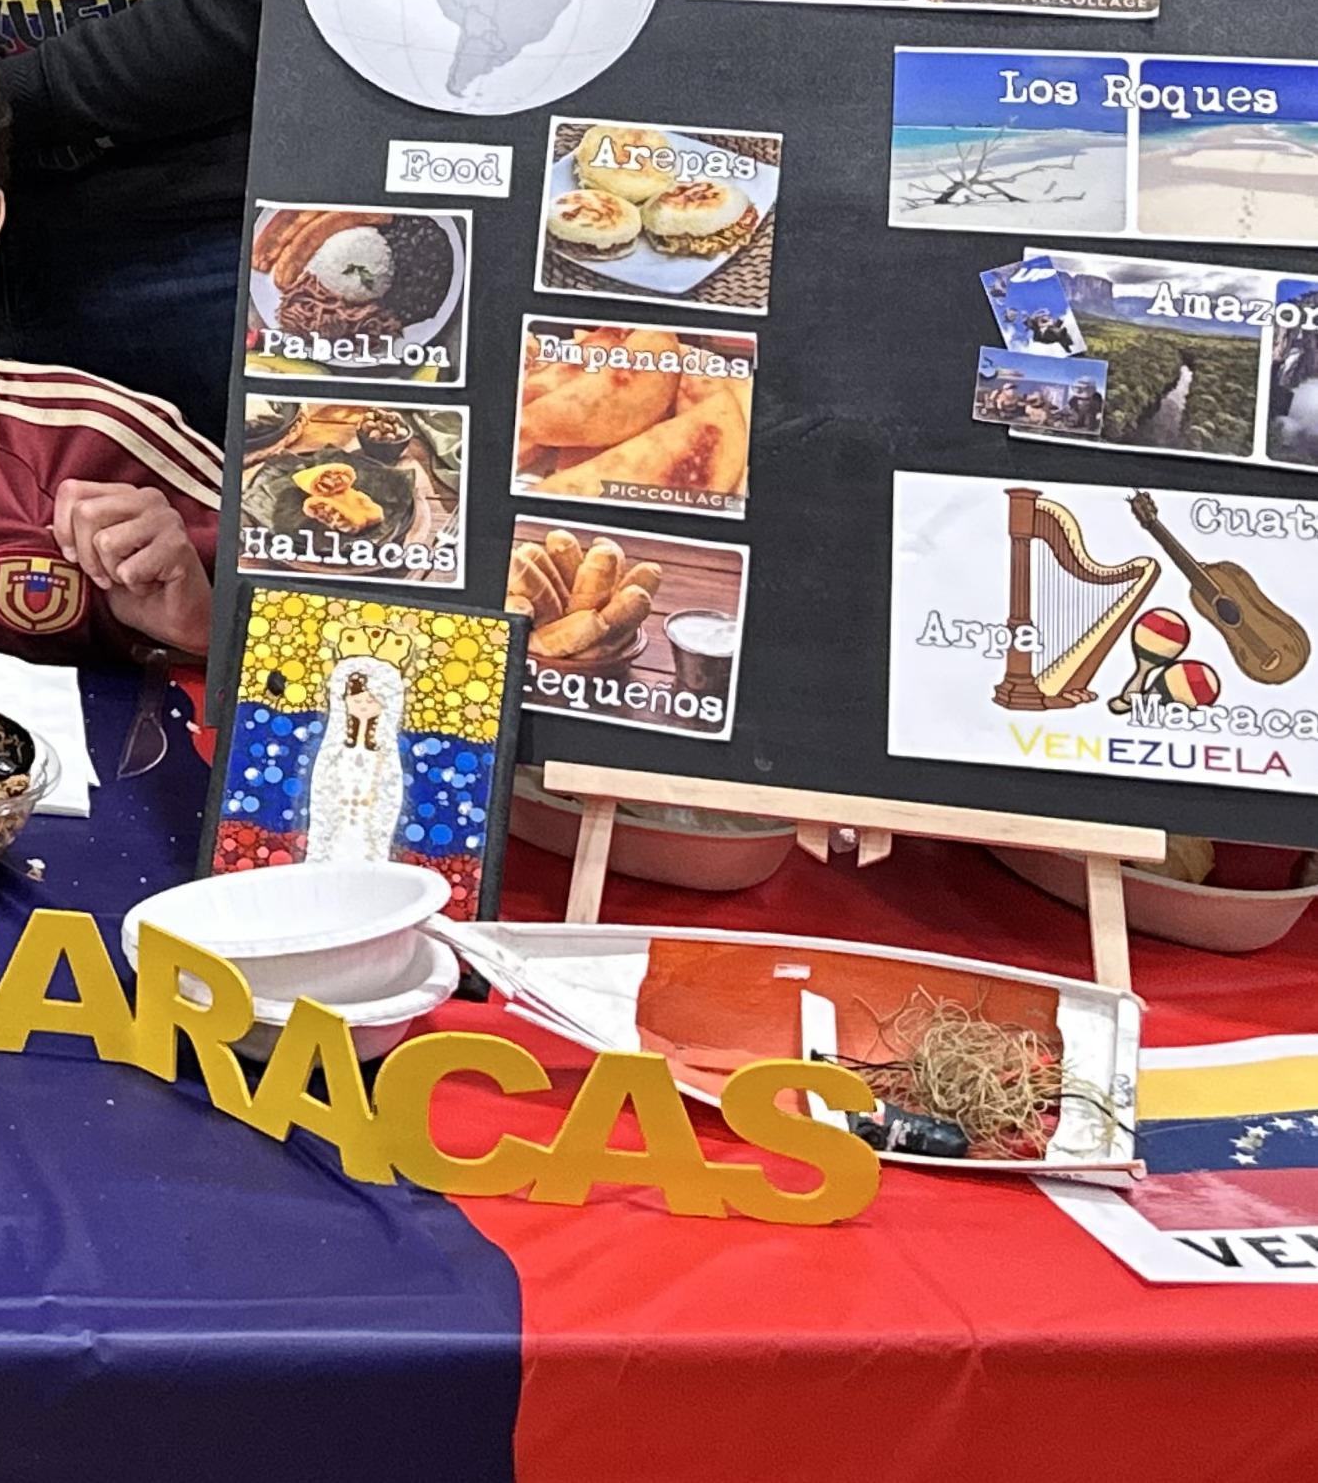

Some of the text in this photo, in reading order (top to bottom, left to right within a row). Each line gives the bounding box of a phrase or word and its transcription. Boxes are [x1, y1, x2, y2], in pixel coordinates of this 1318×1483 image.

[998, 69, 1279, 120] Los Roques
[400, 148, 504, 186] Food
[588, 135, 758, 182] Arepas
[258, 328, 451, 370] Pabellon
[533, 334, 752, 380] Empanadas
[240, 525, 458, 573] Hallacas
[916, 609, 1045, 659] Arpa
[1009, 722, 1292, 778] VENEZUELA
